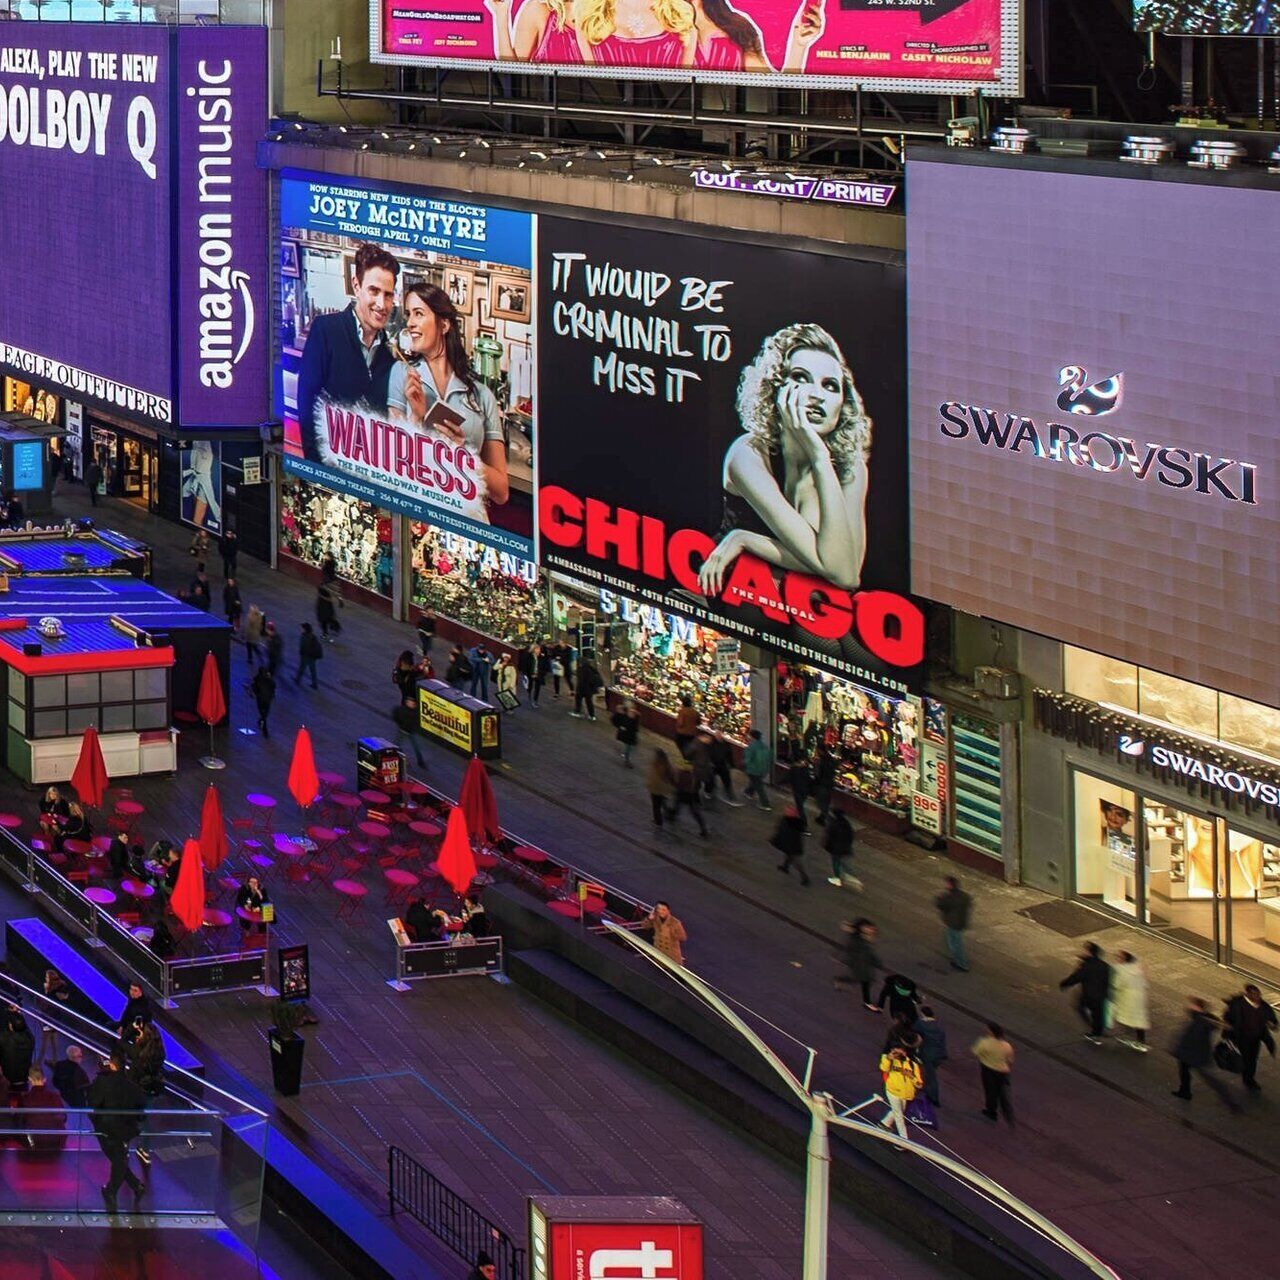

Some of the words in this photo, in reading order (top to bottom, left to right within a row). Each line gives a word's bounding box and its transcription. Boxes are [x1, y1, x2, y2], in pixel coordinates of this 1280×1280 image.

[0, 47, 44, 81] ALEXA,
[48, 50, 82, 78] PLAY
[88, 52, 117, 80] THE
[121, 54, 158, 84] NEW
[127, 94, 157, 179] Q
[186, 59, 233, 204] music
[309, 194, 361, 220] JOEY
[819, 181, 887, 206] PRIME
[338, 221, 381, 238] THROUGH
[383, 228, 411, 243] APRIL
[413, 234, 419, 243] 7
[421, 236, 451, 249] ONLY!
[198, 212, 242, 390] amazon
[552, 252, 584, 292] IT
[584, 259, 668, 304] WOULD
[679, 275, 734, 313] BE
[552, 300, 693, 359] CRIMINAL
[695, 325, 732, 363] TO
[4, 344, 53, 378] EAGLE
[56, 364, 171, 422] OUTFITTERS
[592, 354, 657, 397] MISS
[664, 366, 702, 404] IT
[325, 403, 477, 501] WAITRESS
[939, 400, 1258, 506] SWAROVSKI
[337, 458, 354, 471] THE
[354, 463, 370, 475] HIT
[371, 470, 420, 494] BROADWAY
[421, 486, 463, 510] MUSICAL
[444, 530, 537, 585] GRAND
[539, 484, 925, 668] CHICAGO
[598, 587, 698, 647] SLAM
[730, 586, 756, 602] THE
[758, 593, 816, 622] MUSICAL
[421, 702, 469, 736] Beautiful
